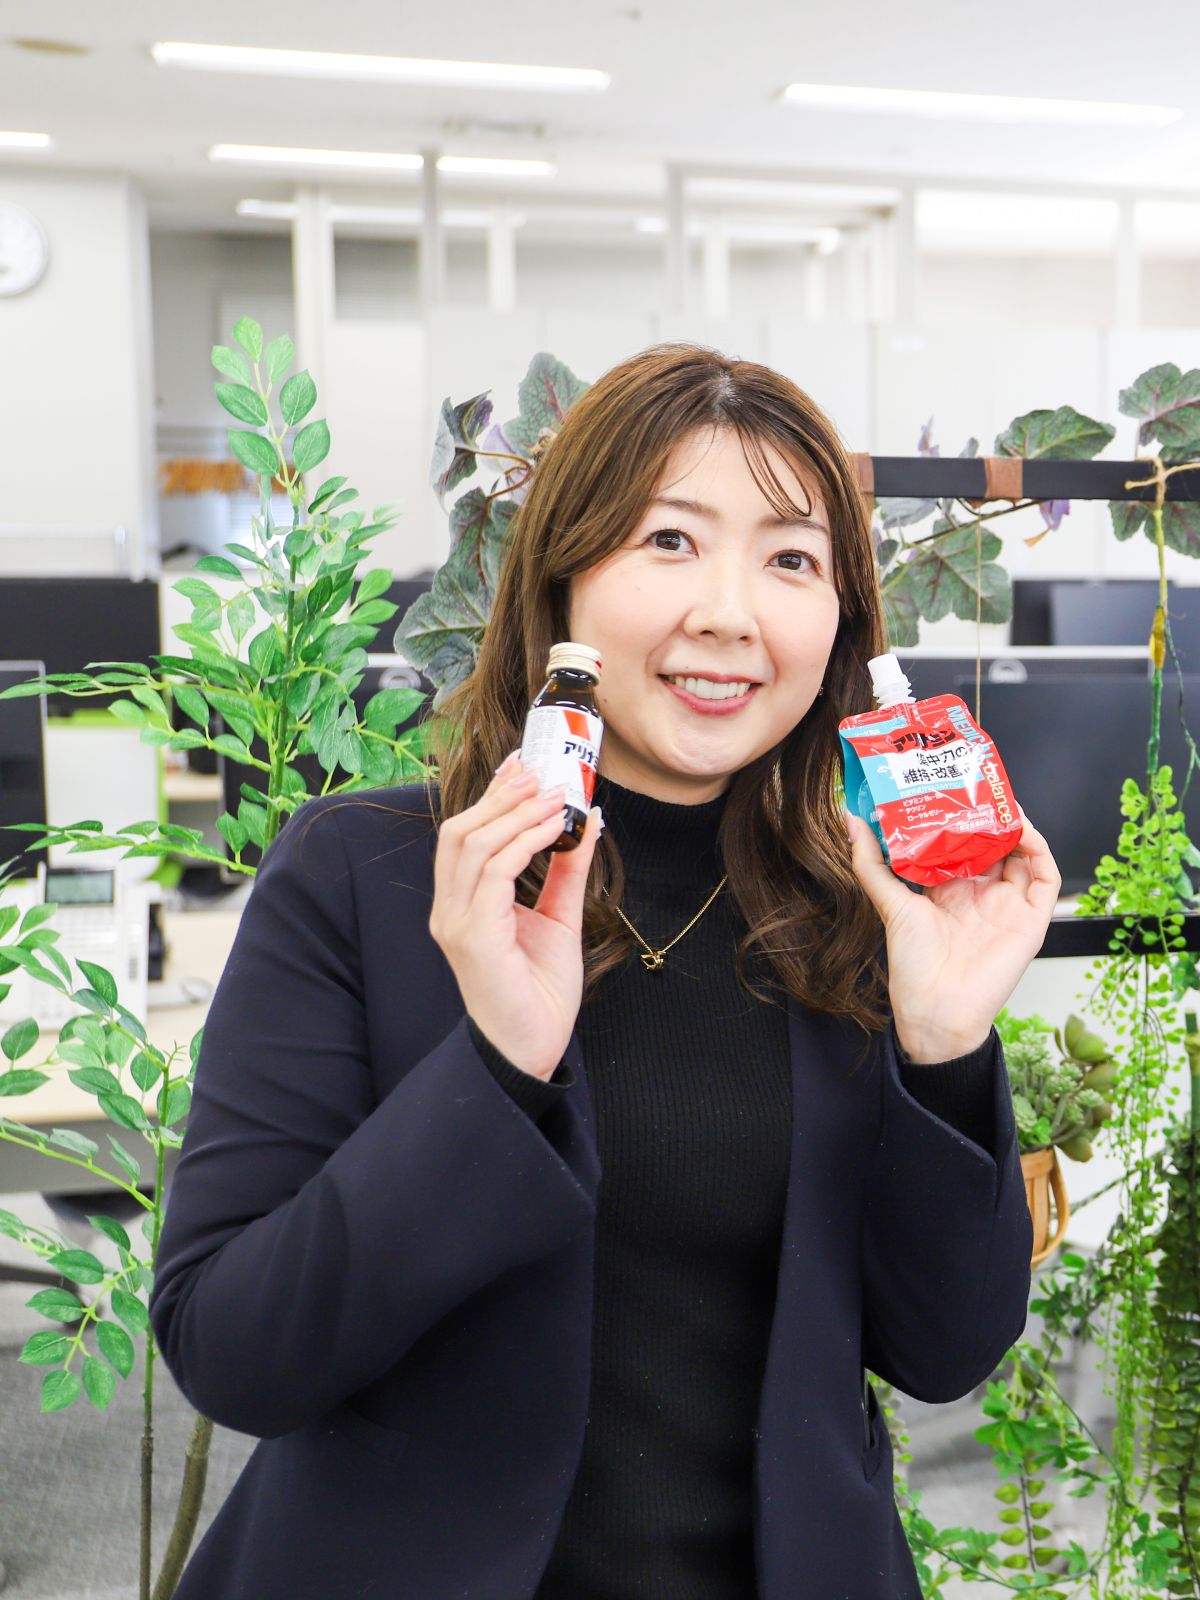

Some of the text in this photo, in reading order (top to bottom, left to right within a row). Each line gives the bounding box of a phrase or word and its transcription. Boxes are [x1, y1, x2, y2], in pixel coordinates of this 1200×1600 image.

[902, 763, 970, 784] 維持・改善
[982, 761, 1013, 824] balance
